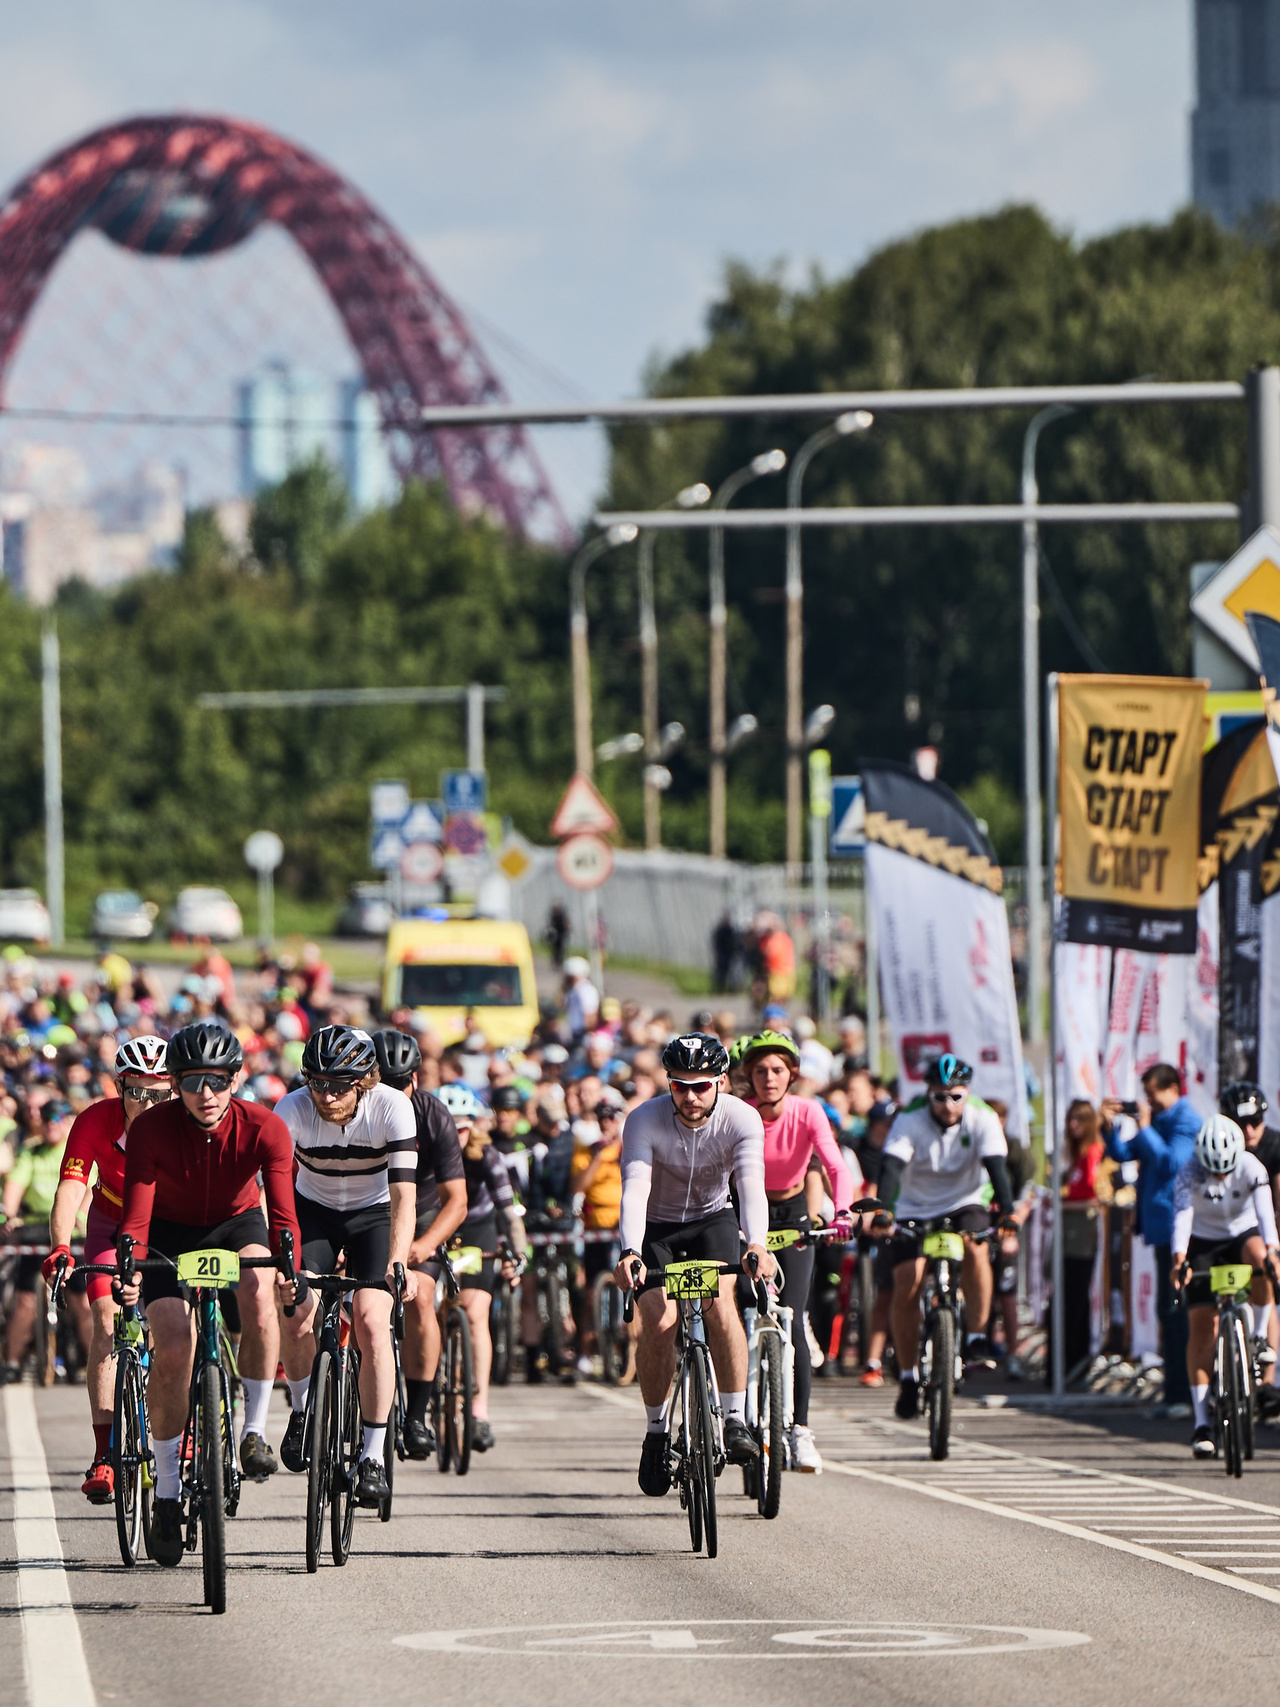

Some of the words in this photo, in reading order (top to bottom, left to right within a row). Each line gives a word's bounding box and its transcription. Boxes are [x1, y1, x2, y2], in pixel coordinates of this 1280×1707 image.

[1084, 725, 1177, 777] СТАРТ
[1086, 784, 1171, 836] СТАРТ
[1087, 841, 1170, 895] СТАРТ
[767, 1234, 784, 1245] 26
[198, 1256, 220, 1276] 20
[683, 1268, 703, 1288] 33
[1228, 1271, 1236, 1285] 5
[526, 1629, 972, 1649] 40
